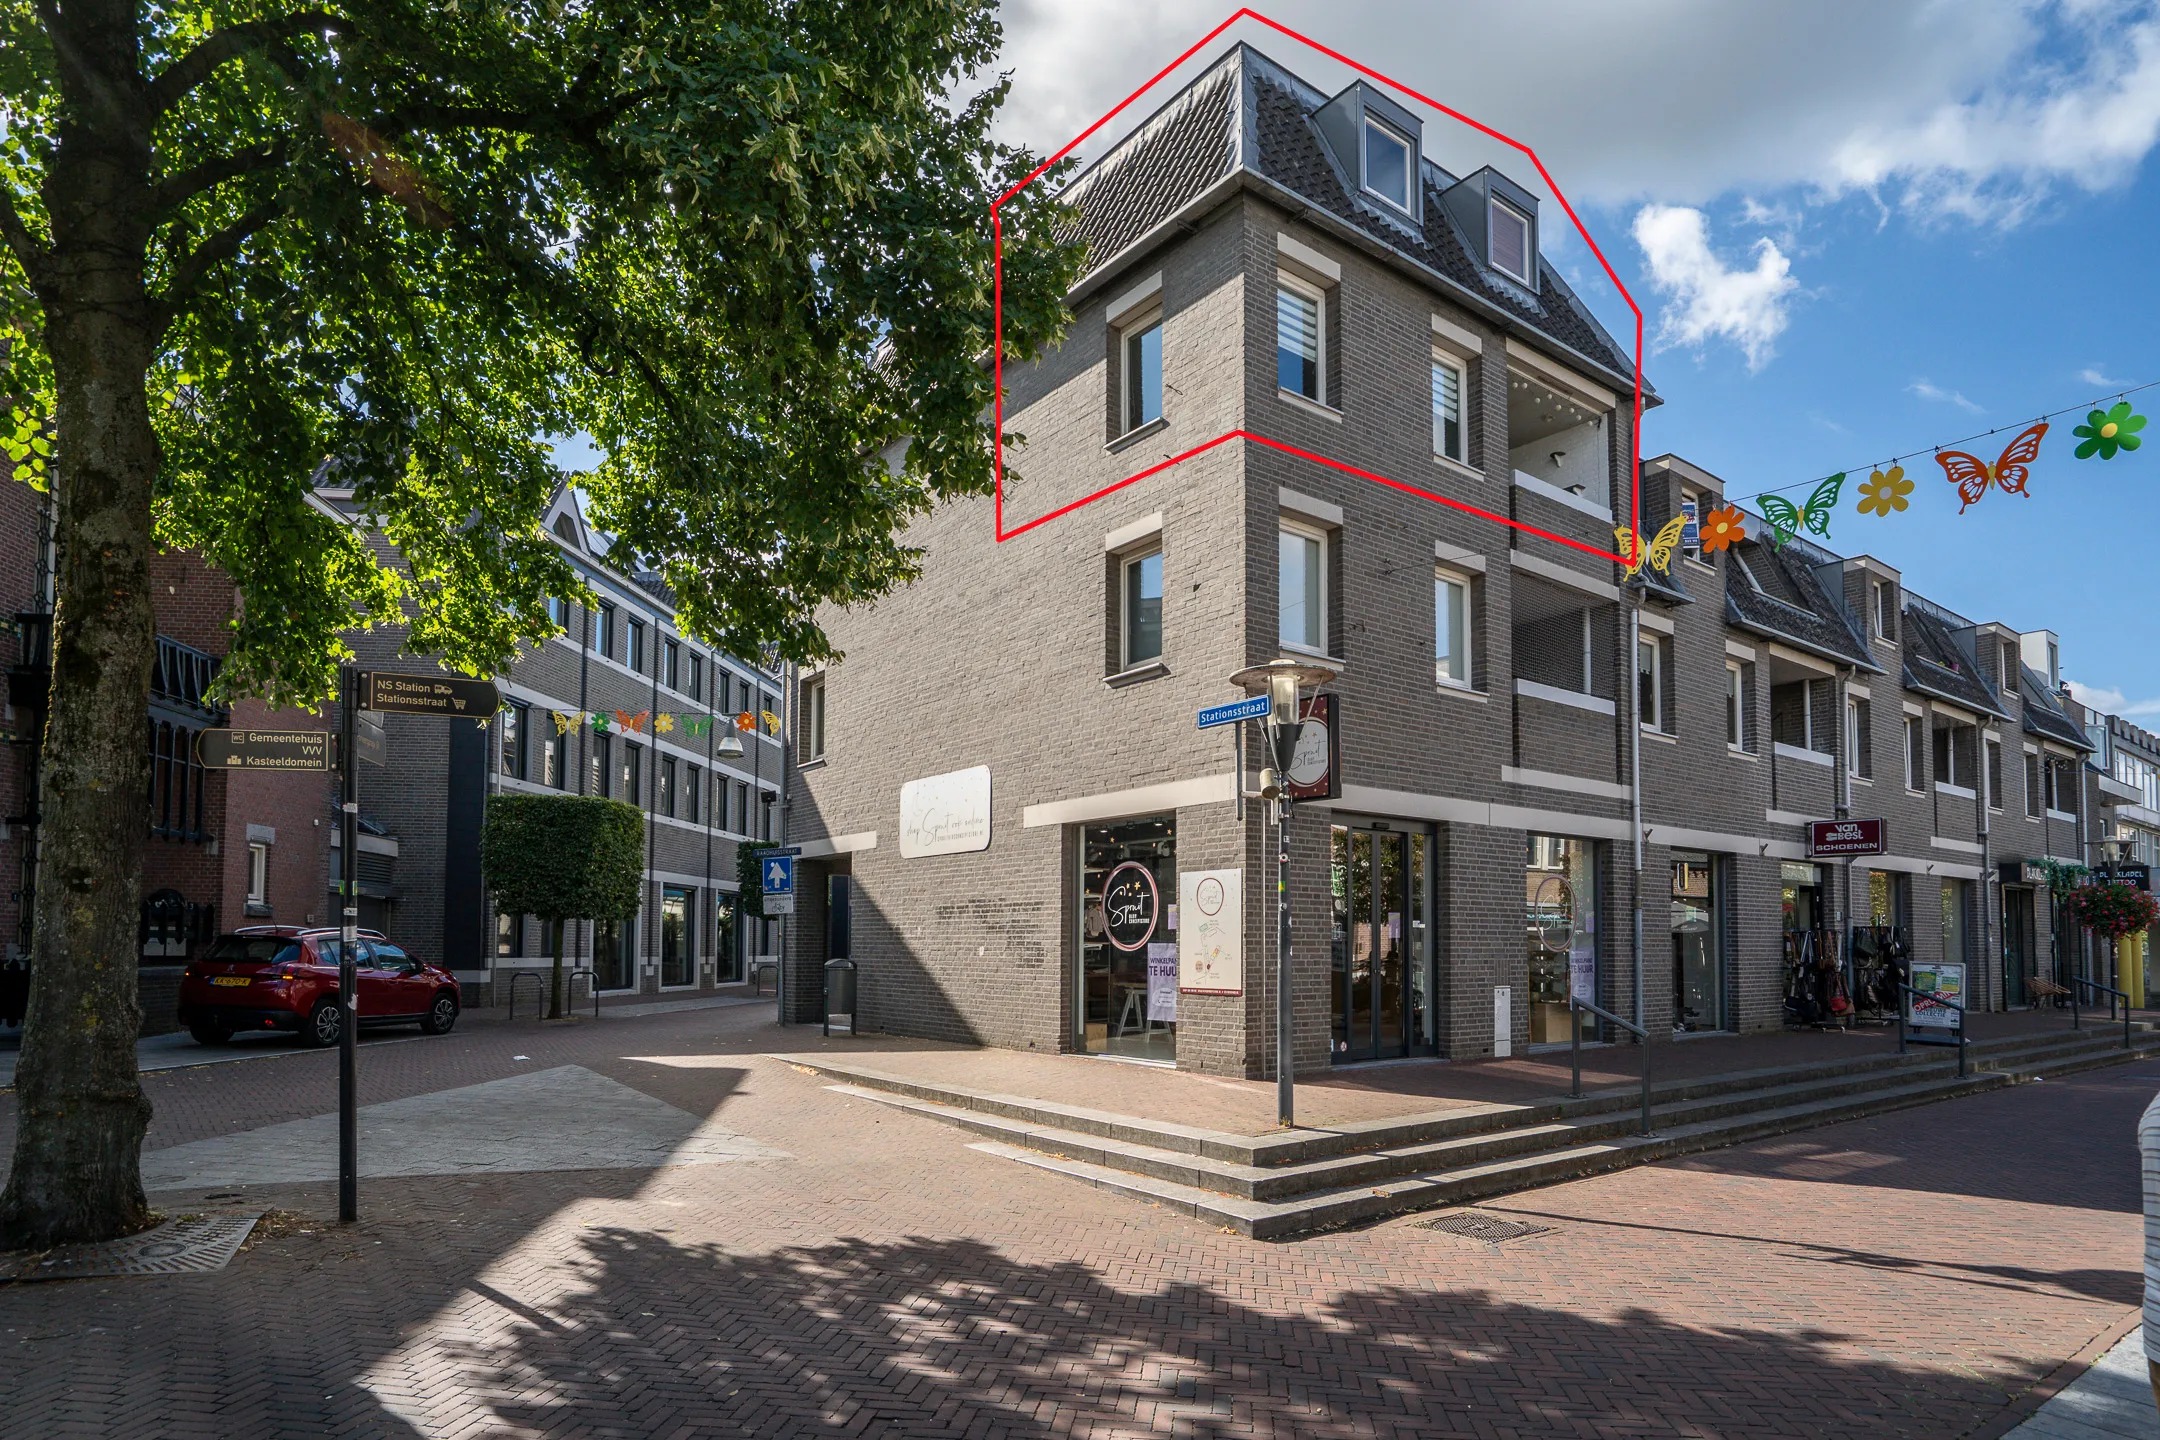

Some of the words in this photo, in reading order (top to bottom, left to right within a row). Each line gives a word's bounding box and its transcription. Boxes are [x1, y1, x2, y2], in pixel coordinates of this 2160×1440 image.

[377, 680, 393, 690] NS
[395, 681, 430, 692] Station
[376, 693, 447, 707] Stationsstraat
[1201, 701, 1265, 723] Stationsstraat
[249, 732, 323, 744] Gemeentehuis
[302, 746, 322, 755] VVV
[246, 755, 322, 767] Kasteeldomein
[1834, 823, 1858, 833] van
[756, 848, 798, 856] RAADHUISSTRAAT
[1816, 842, 1878, 851] SCHOENEN
[2099, 870, 2144, 878] BLKLABEL
[1149, 966, 1158, 976] TE
[1160, 966, 1177, 977] HUU
